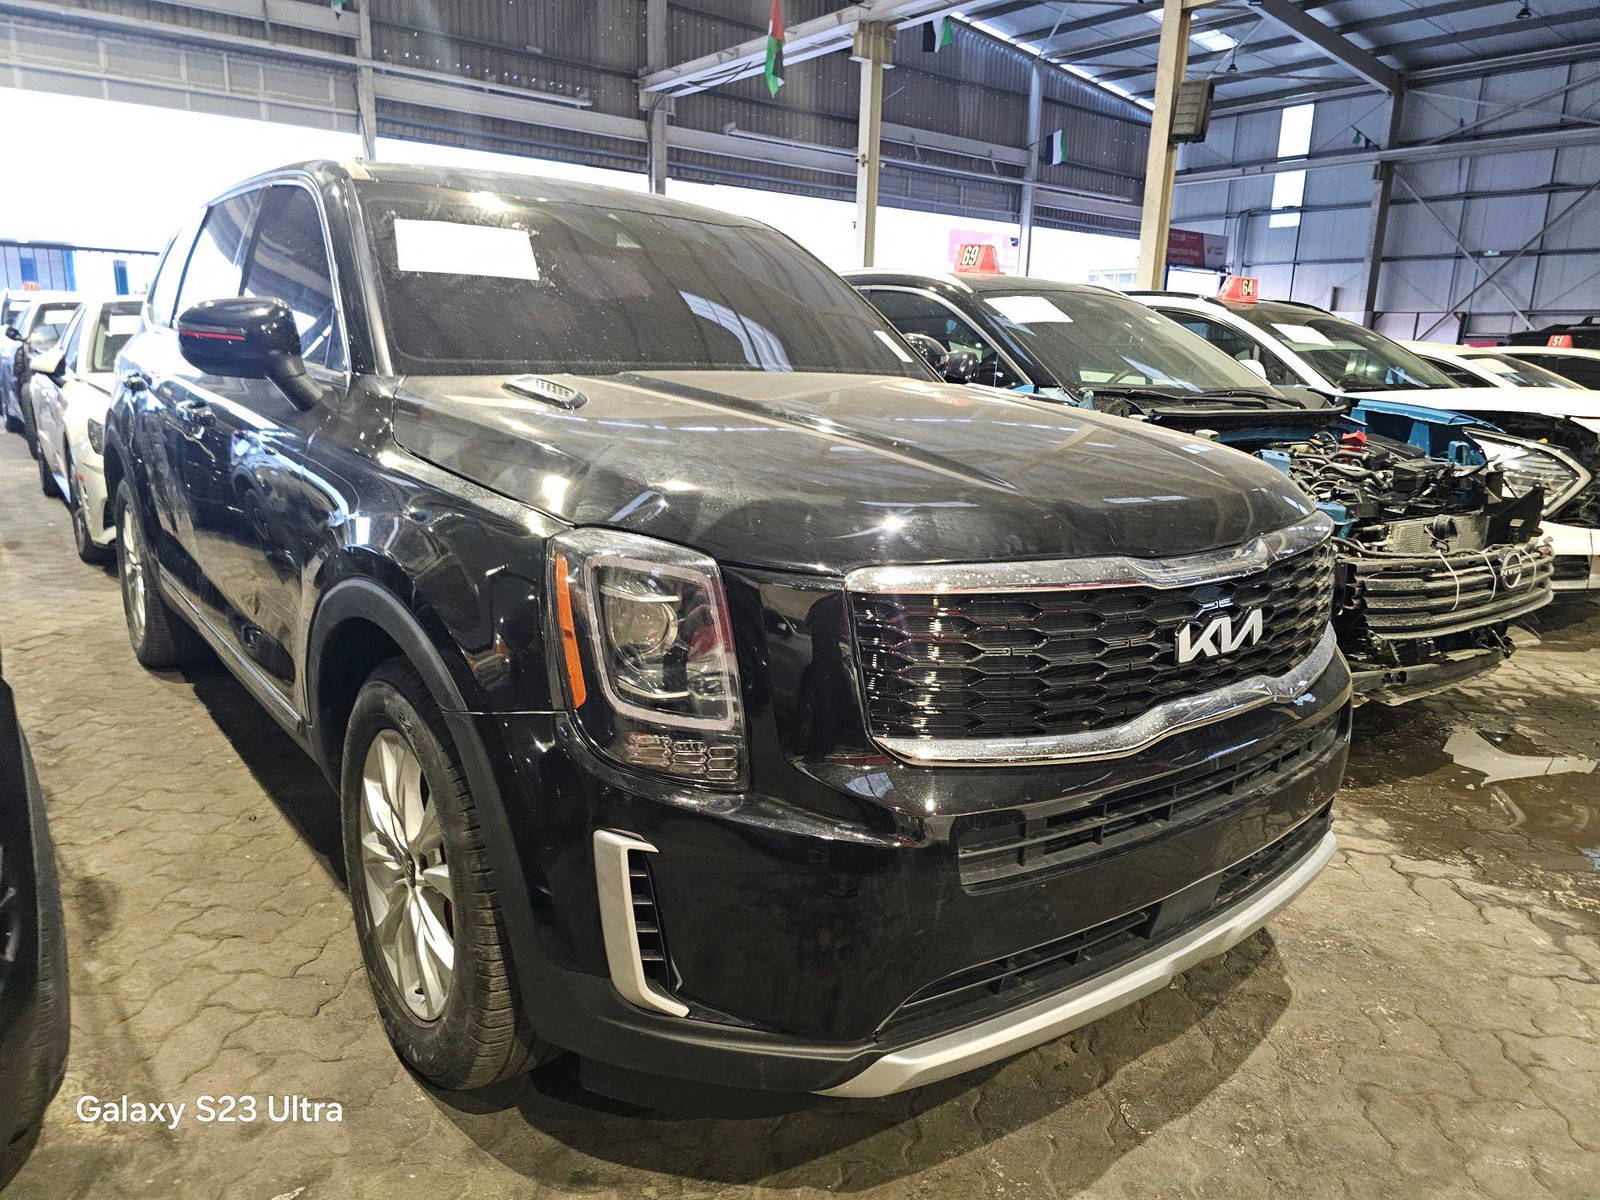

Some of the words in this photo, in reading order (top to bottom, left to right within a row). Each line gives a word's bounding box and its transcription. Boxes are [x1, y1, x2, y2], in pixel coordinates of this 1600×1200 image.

[961, 246, 980, 265] 69
[1242, 280, 1254, 296] 64
[1178, 608, 1263, 663] KIA
